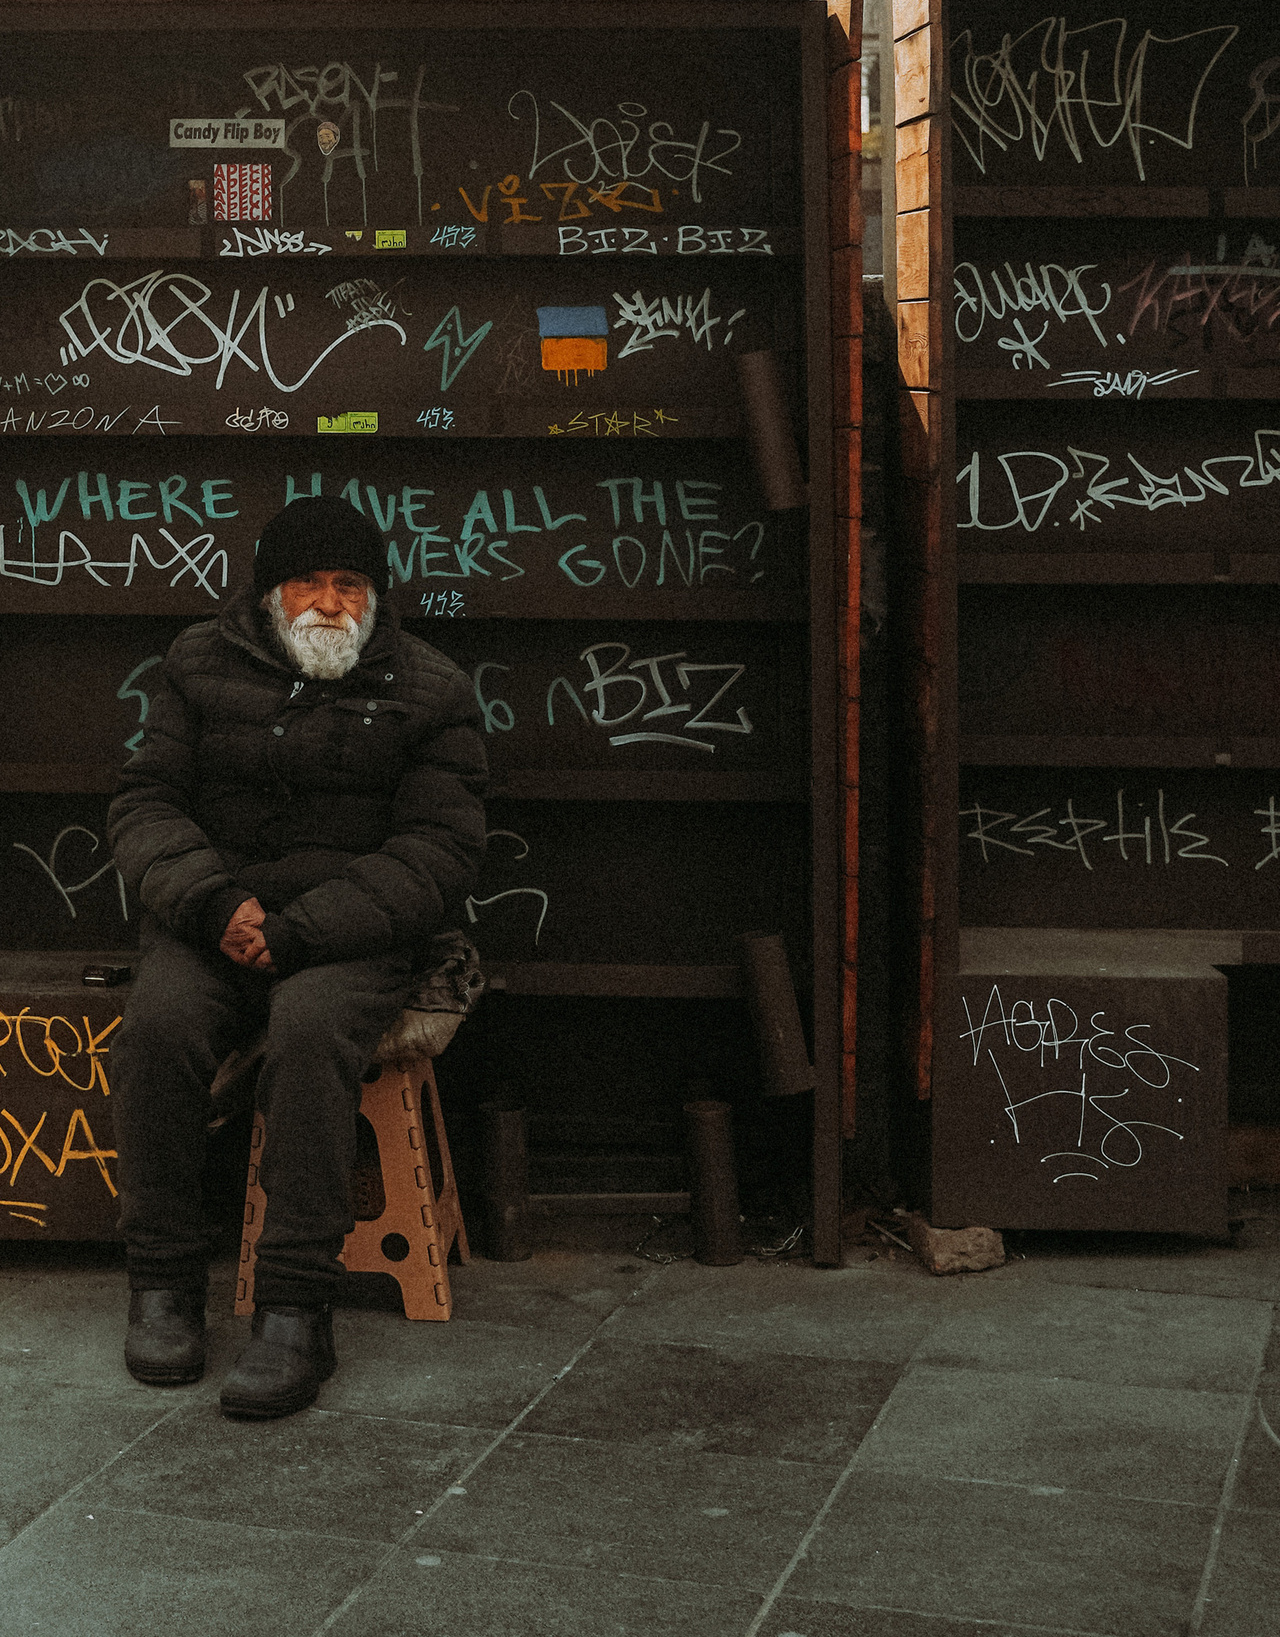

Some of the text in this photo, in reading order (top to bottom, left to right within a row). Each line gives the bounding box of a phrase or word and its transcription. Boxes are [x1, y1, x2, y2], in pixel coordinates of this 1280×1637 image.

[173, 122, 281, 145] Candy Flip Boy
[15, 471, 239, 528] WHERE
[460, 485, 587, 540] ALL
[596, 476, 722, 529] THE
